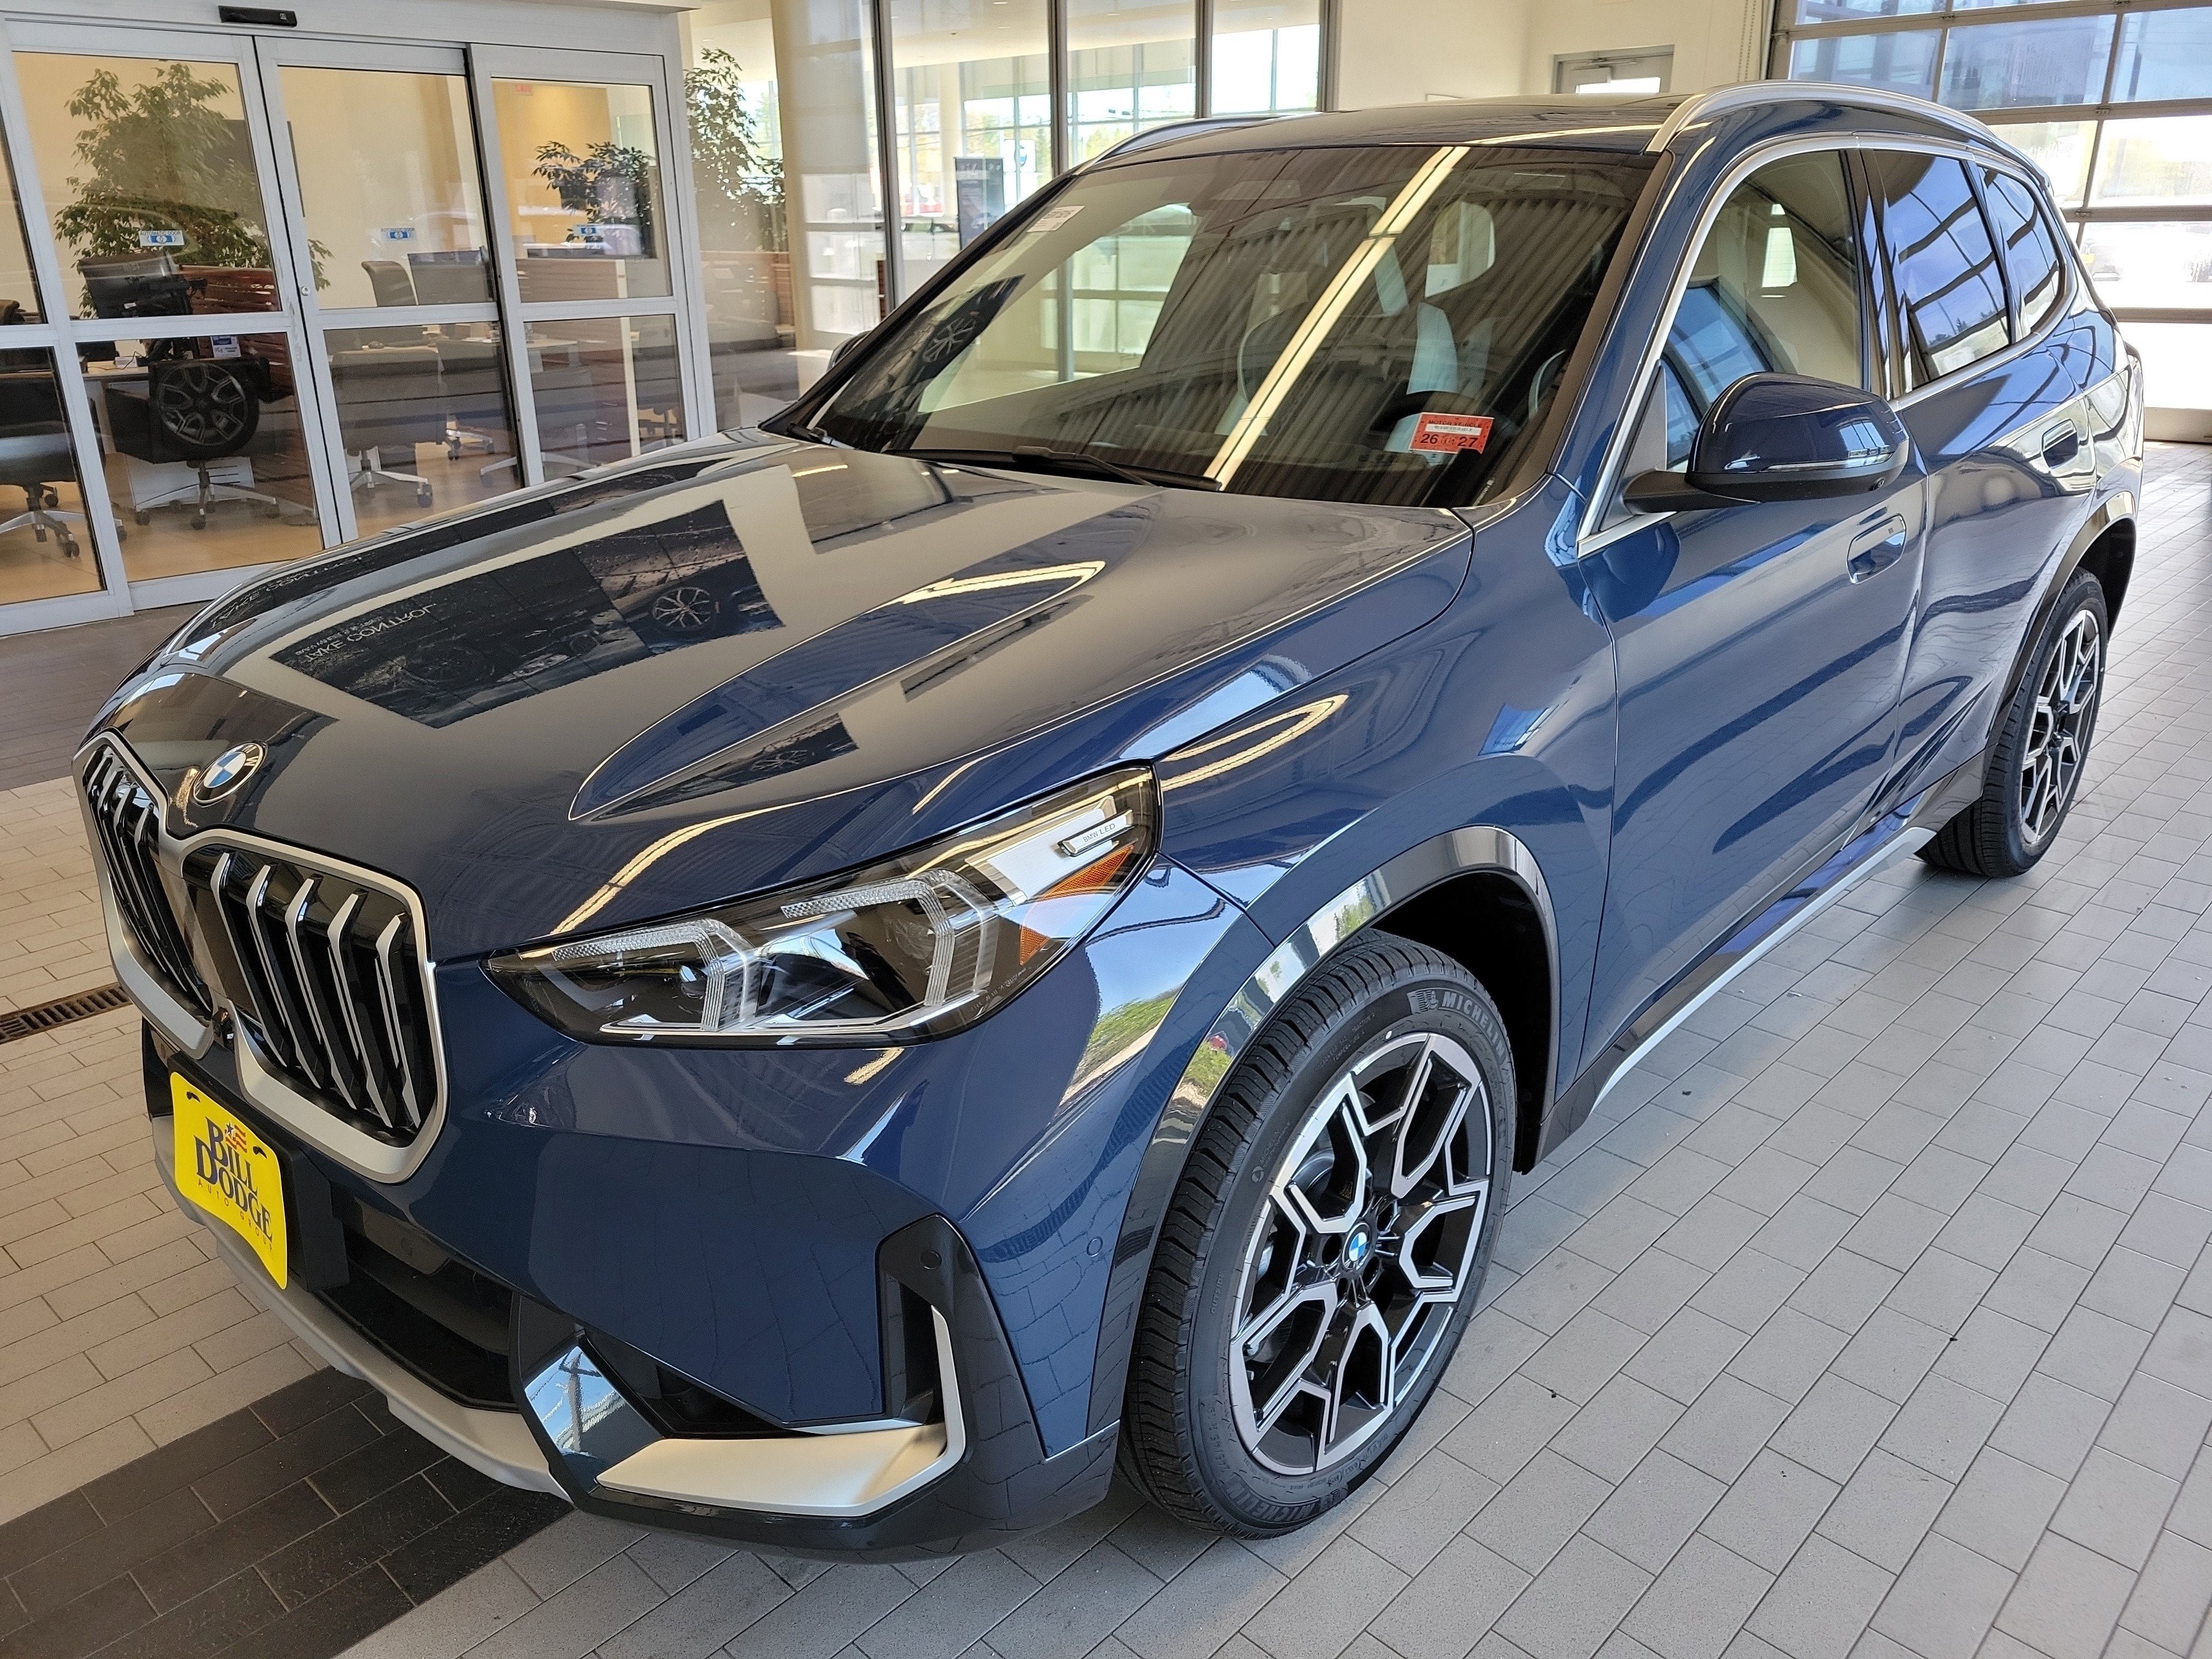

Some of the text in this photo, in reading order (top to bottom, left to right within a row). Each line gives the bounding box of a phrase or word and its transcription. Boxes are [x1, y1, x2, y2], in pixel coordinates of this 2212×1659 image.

[1420, 434, 1439, 444] 26
[1457, 437, 1478, 447] 27
[1083, 823, 1115, 842] BMW LED
[1442, 991, 1509, 1071] MICHELIN
[206, 1116, 258, 1197] BILL
[194, 1135, 273, 1243] DODGE
[198, 1179, 272, 1252] AUTO GROUP
[1226, 1484, 1316, 1522] MICHELIN
